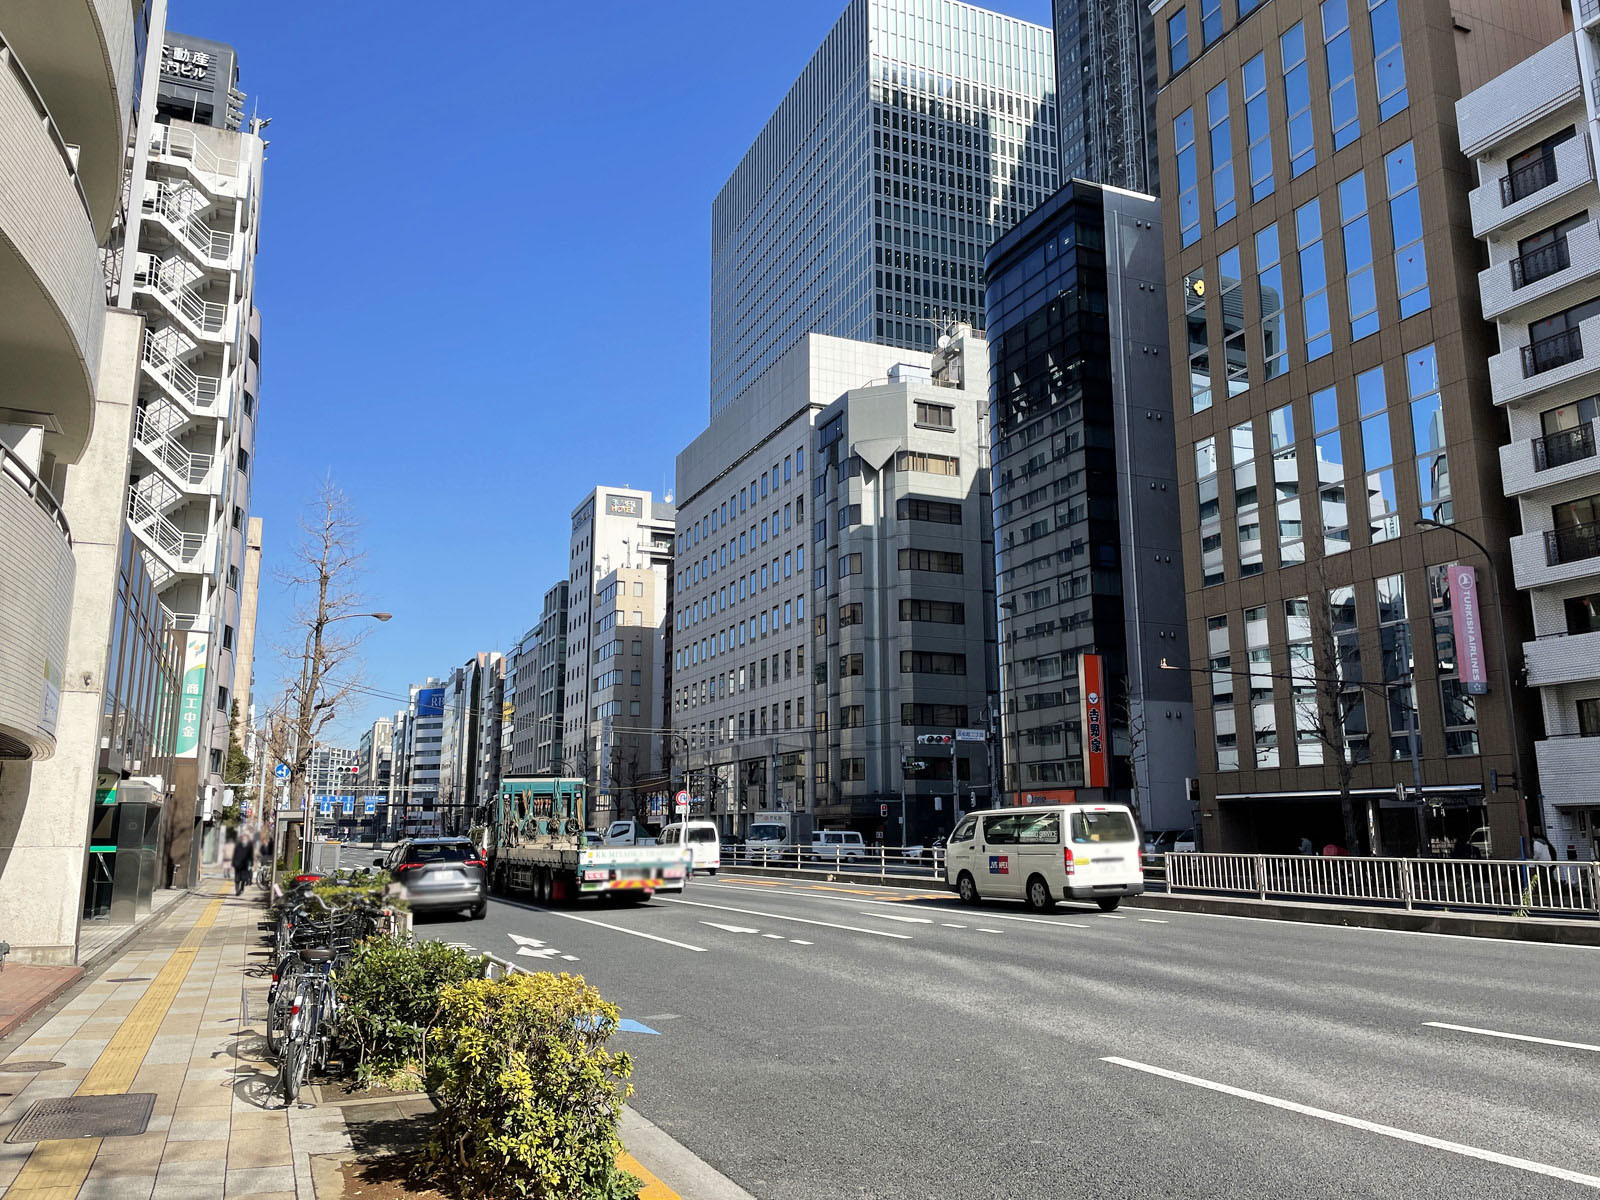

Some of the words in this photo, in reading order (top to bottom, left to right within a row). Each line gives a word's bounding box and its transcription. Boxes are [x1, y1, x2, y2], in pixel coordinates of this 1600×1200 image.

[1463, 591, 1475, 634] TURKISH
[1468, 635, 1480, 681] AIRLINES
[182, 683, 200, 737] 商工中金
[1088, 708, 1102, 753] 吉野家
